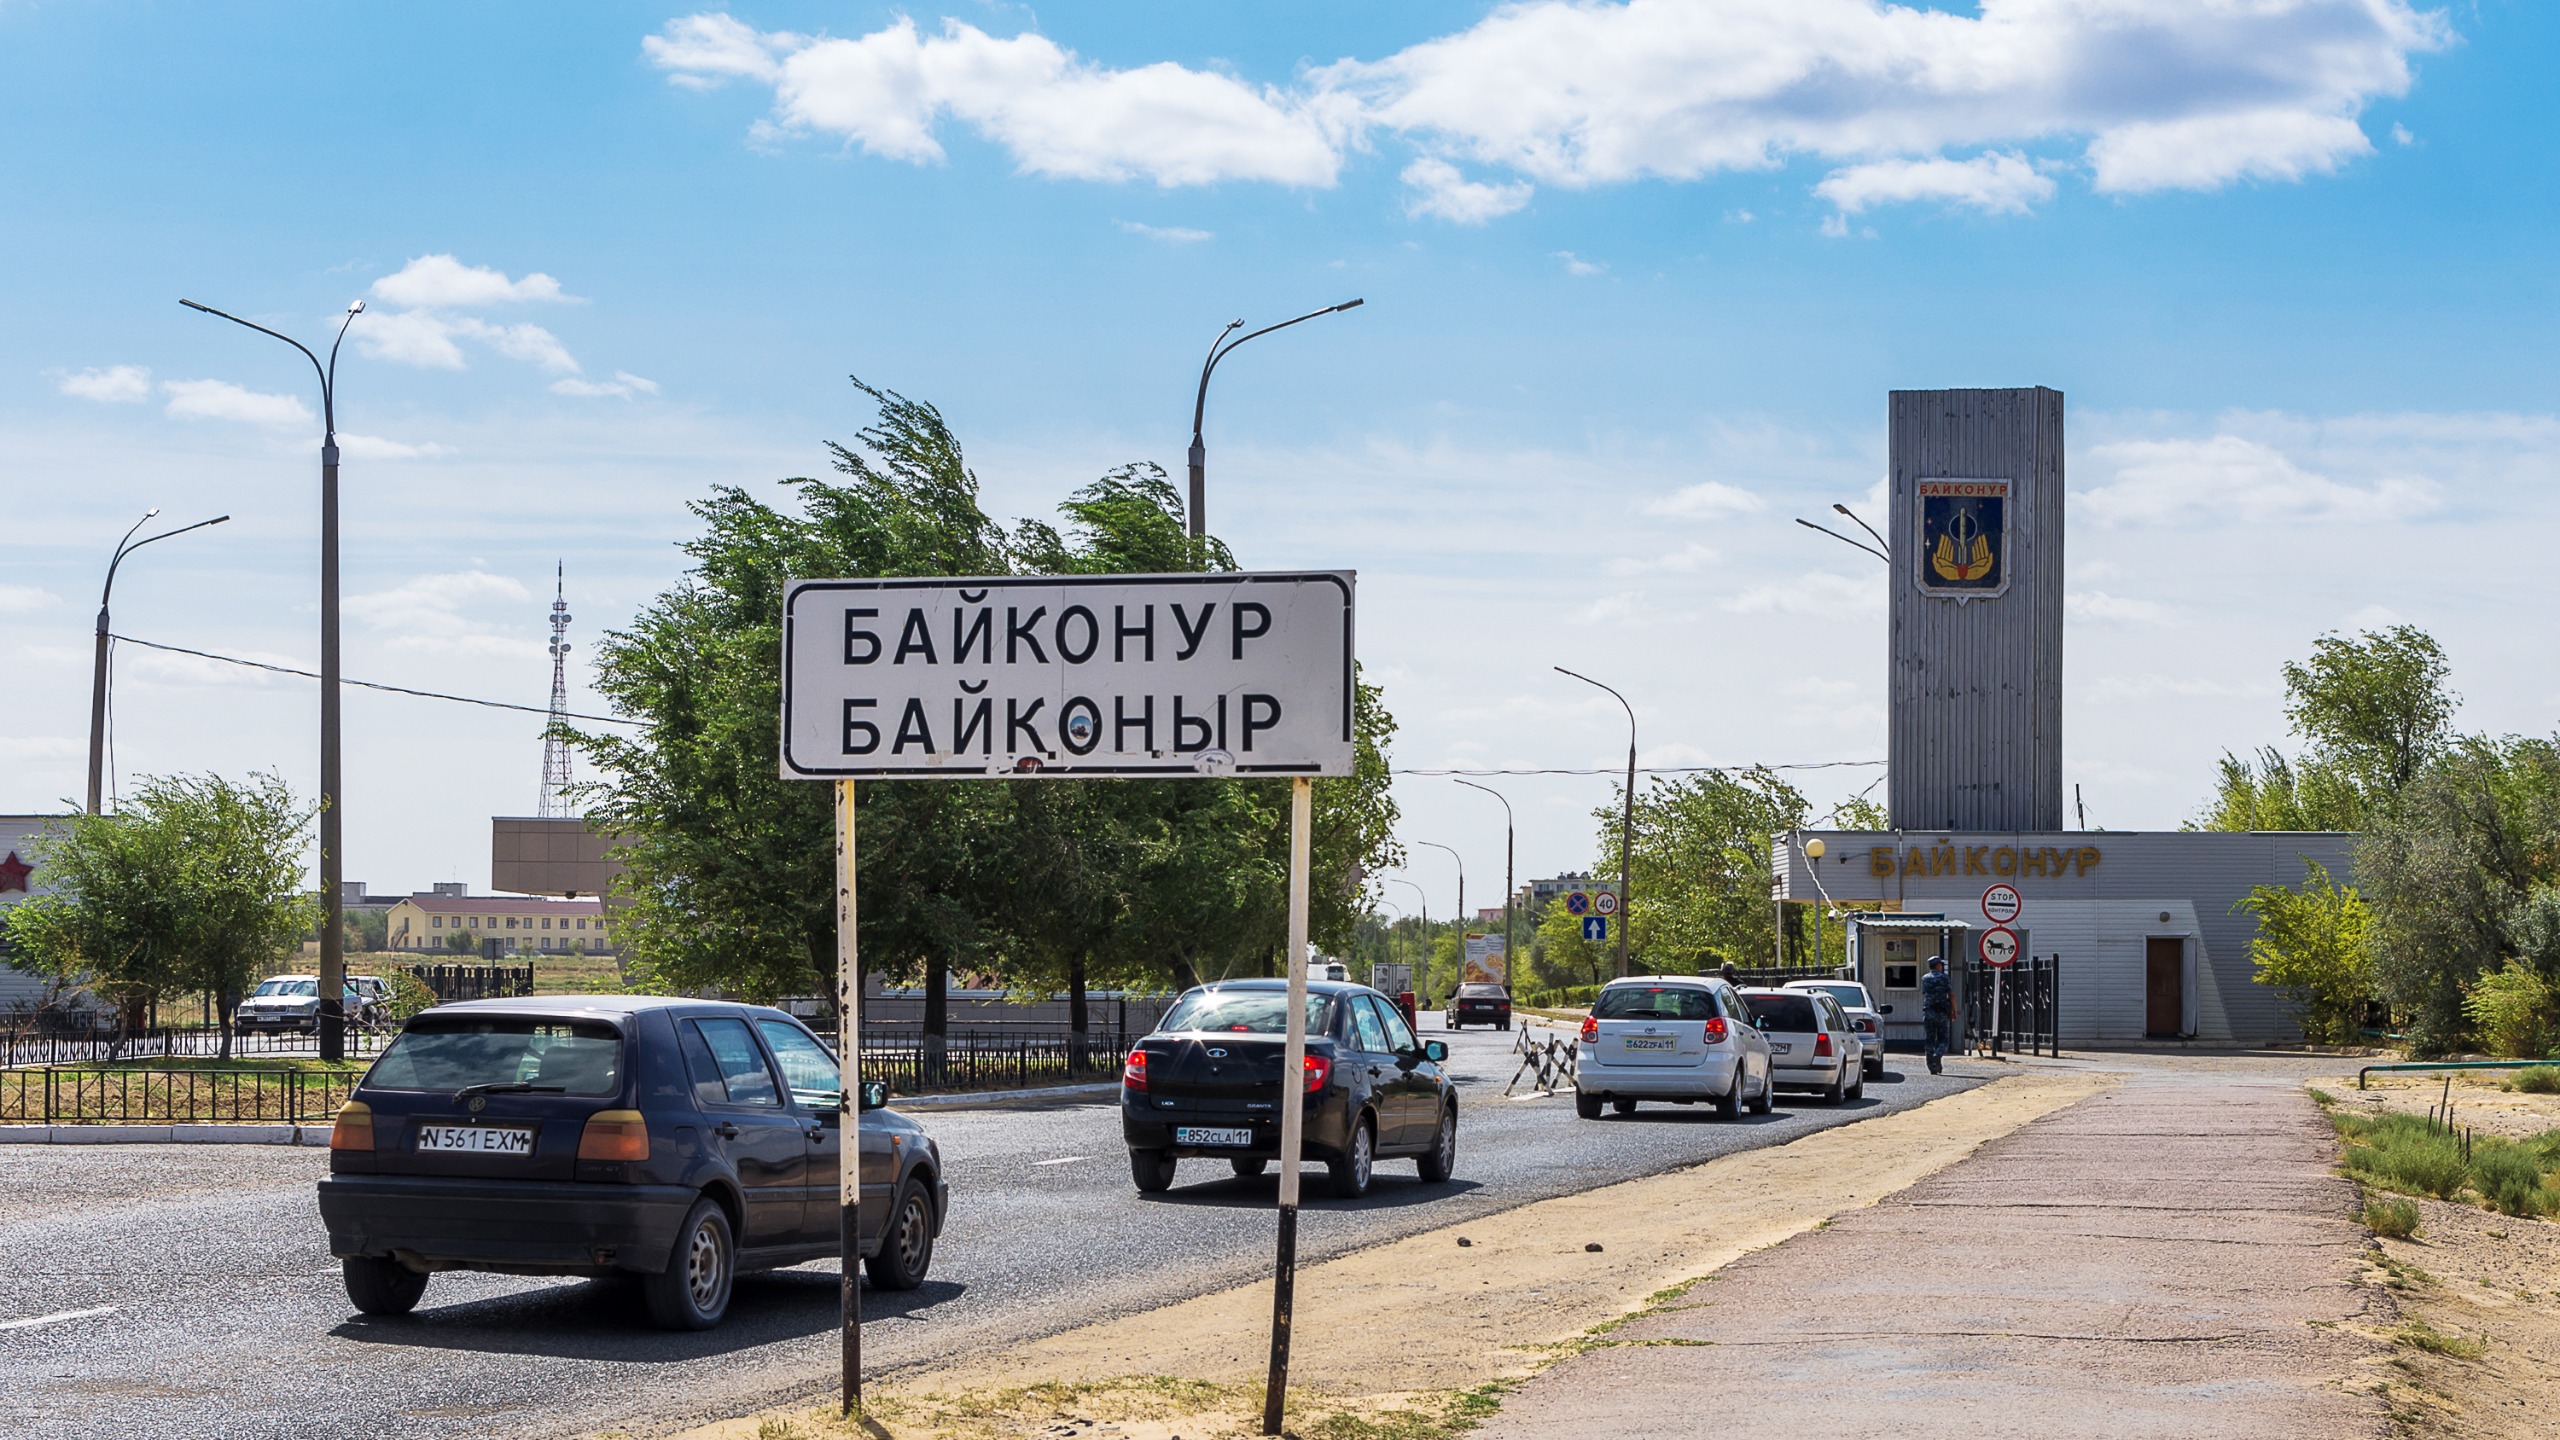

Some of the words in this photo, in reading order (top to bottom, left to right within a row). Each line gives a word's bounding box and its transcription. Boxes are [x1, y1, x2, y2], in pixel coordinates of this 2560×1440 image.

[1920, 483, 2008, 495] БАЙКОНУР
[844, 589, 1272, 665] БАЙКОНУР
[1871, 838, 2102, 877] БАЙКОНУР
[1991, 893, 2014, 901] STOP
[1599, 899, 1613, 909] 40
[1665, 1040, 1673, 1048] 11
[424, 1128, 439, 1148] N
[444, 1129, 477, 1149] 561
[484, 1131, 527, 1151] EXM
[1236, 1131, 1249, 1143] 11
